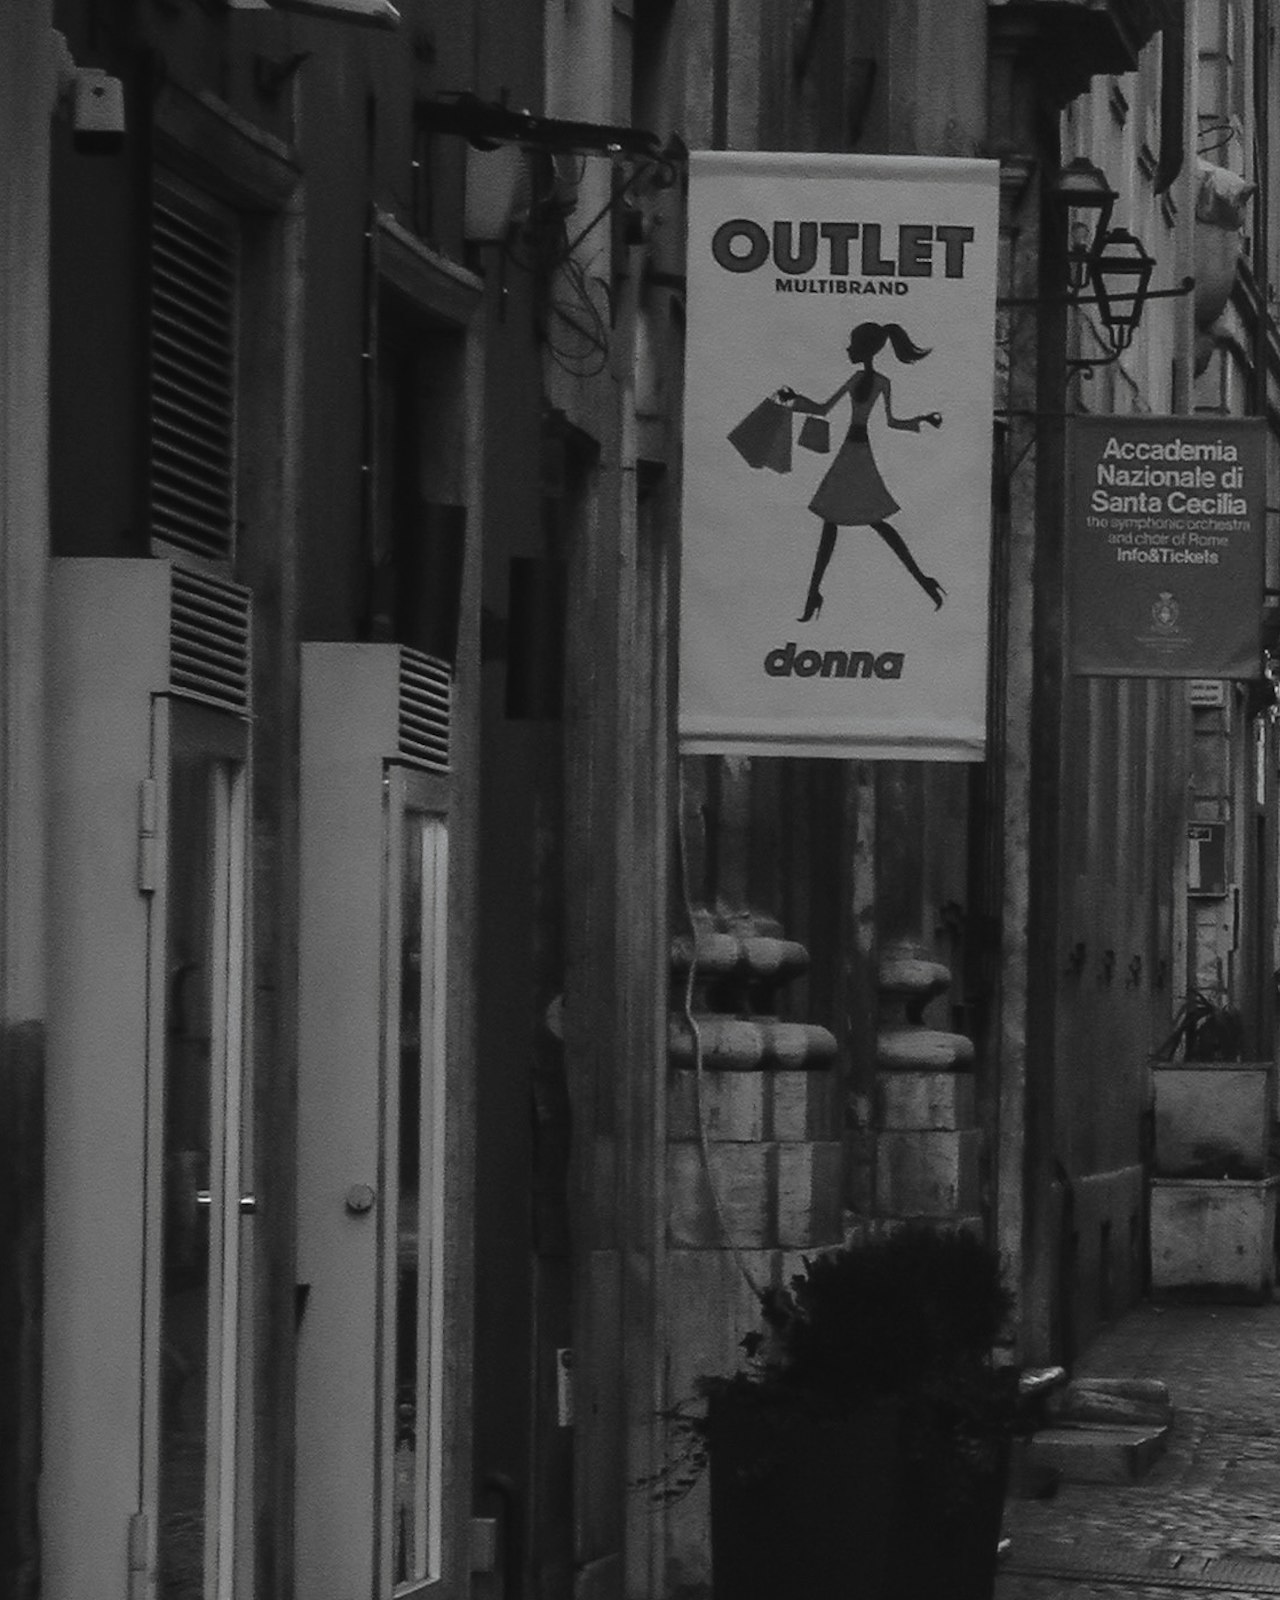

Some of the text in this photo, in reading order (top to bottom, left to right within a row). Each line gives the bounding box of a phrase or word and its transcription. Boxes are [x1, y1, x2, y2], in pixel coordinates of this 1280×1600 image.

[711, 218, 975, 279] OUTLET
[775, 279, 909, 296] MULTIBRAND
[1103, 437, 1238, 462] Accademia
[1097, 464, 1244, 489] Nazionale di
[1091, 490, 1247, 515] Santa Cecilia
[1086, 516, 1250, 532] the symphonic orchestra
[1108, 532, 1229, 547] and choir of Rome
[1117, 548, 1220, 564] Info&Tickets
[764, 643, 905, 680] donna
